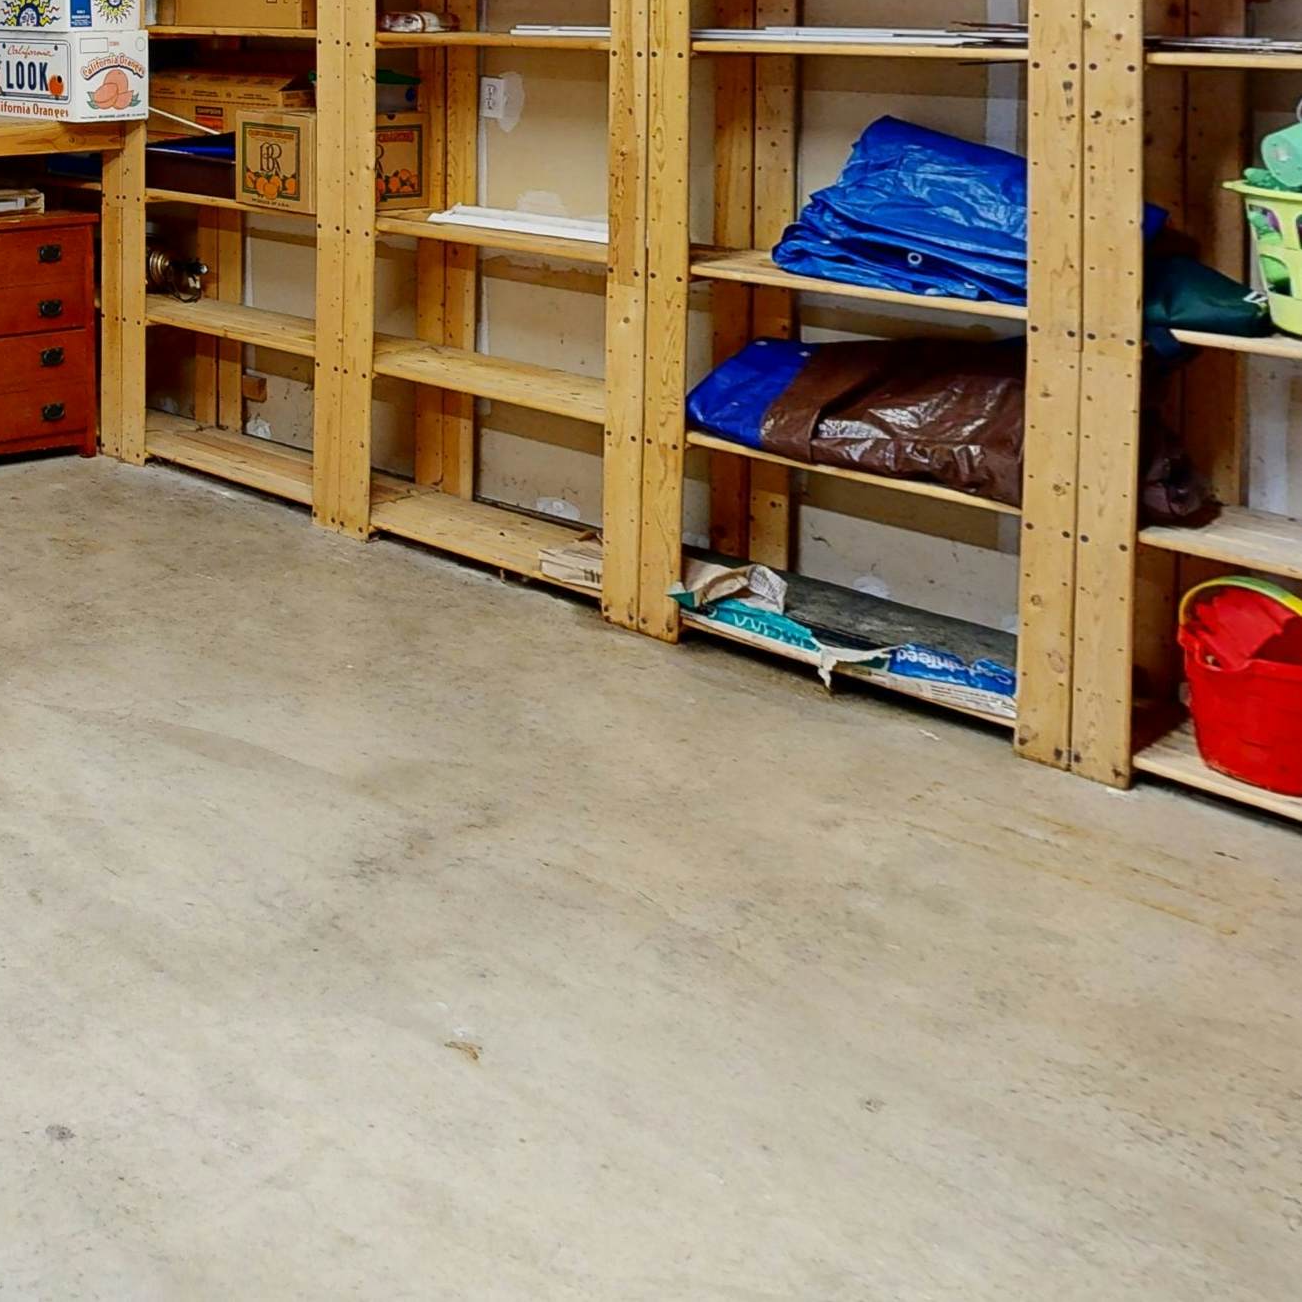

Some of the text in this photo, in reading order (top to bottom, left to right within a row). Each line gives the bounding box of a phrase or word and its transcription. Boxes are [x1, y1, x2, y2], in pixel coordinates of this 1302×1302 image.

[7, 44, 55, 59] California
[82, 52, 118, 78] California
[6, 60, 49, 92] LOOK
[32, 104, 70, 118] Oranges
